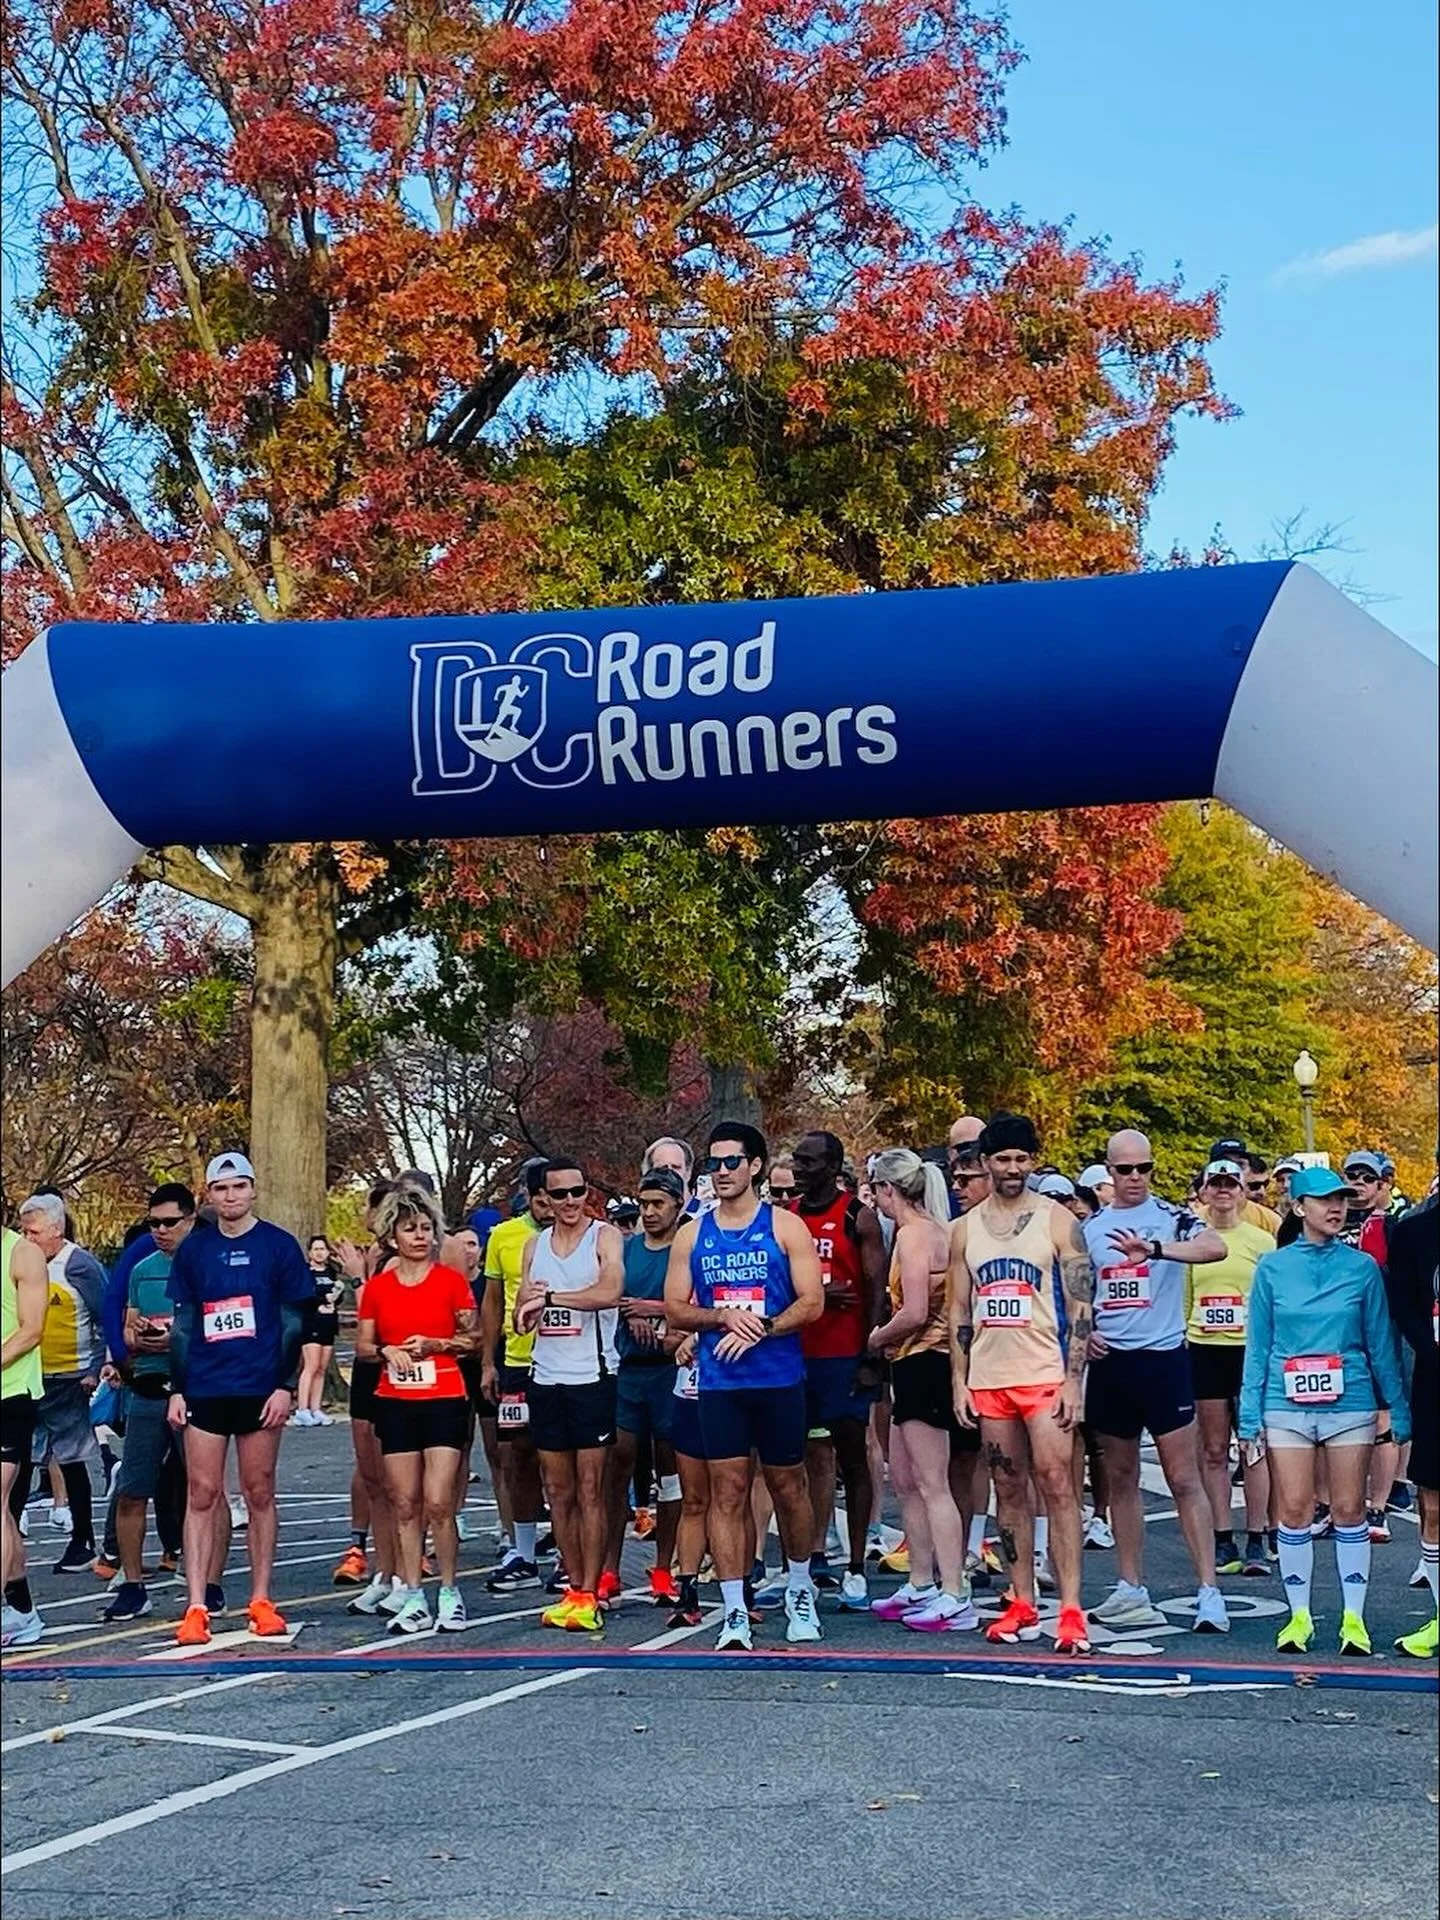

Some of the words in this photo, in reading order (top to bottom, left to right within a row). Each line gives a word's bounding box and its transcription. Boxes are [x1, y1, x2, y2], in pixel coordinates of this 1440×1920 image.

[597, 621, 776, 703] Road
[410, 633, 594, 796] DC
[597, 704, 897, 785] Runners
[701, 1254, 721, 1271] DC
[726, 1250, 768, 1268] ROAD
[703, 1266, 768, 1285] RUNNERS
[1108, 1281, 1139, 1300] 968
[542, 1309, 571, 1327] 439
[986, 1299, 1021, 1317] 600
[1206, 1308, 1234, 1324] 958
[213, 1311, 244, 1332] 446
[1295, 1373, 1332, 1393] 202
